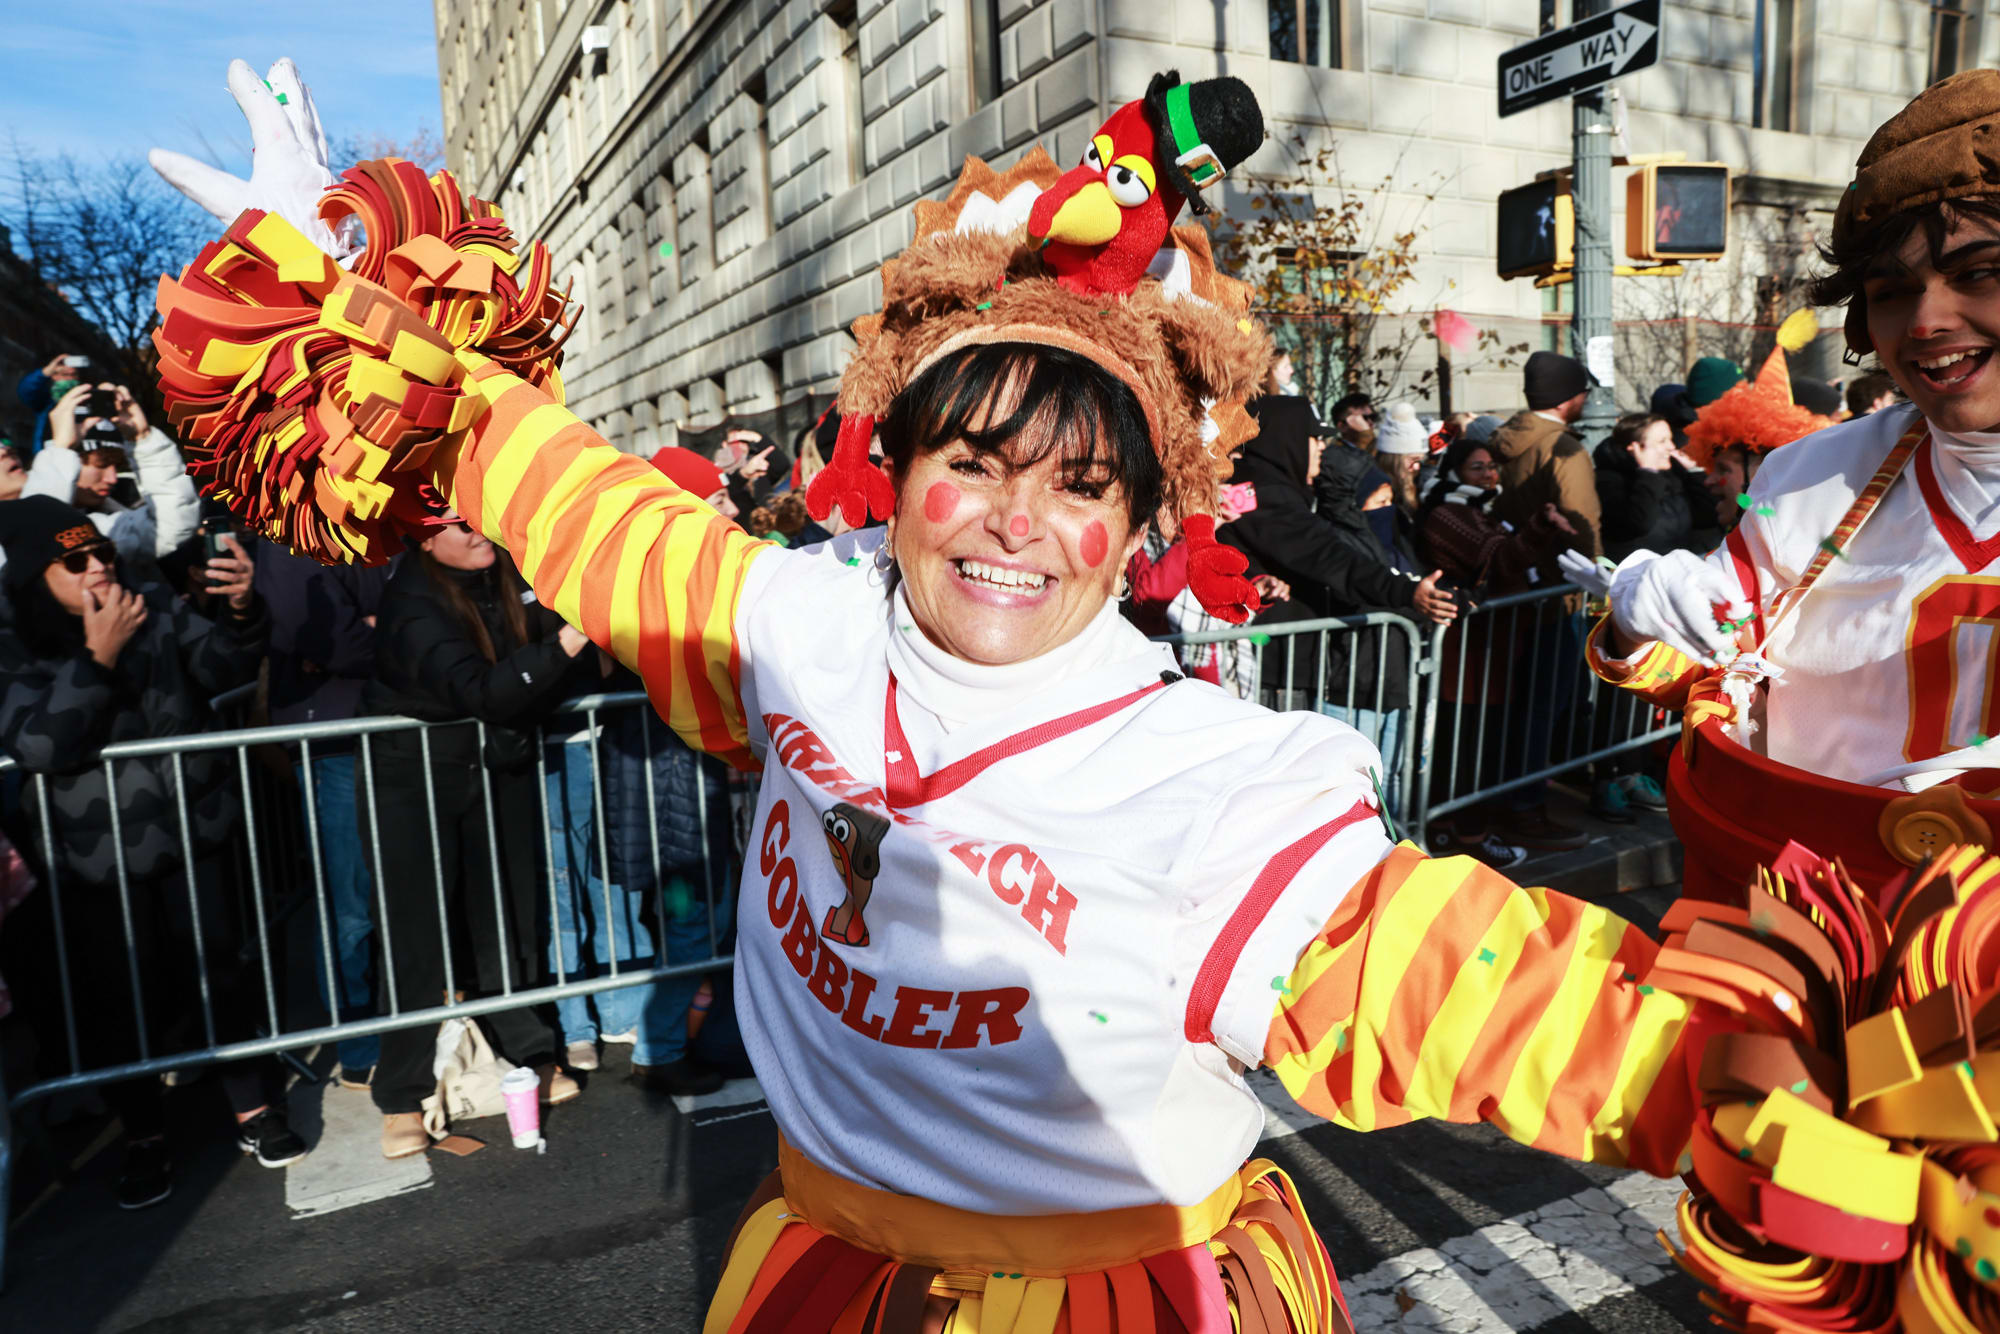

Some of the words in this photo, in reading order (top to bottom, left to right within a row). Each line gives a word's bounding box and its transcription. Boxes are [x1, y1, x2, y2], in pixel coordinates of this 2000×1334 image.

[1510, 56, 1553, 93] ONE
[1581, 25, 1635, 67] WAY
[761, 799, 1030, 1049] GOBBLER
